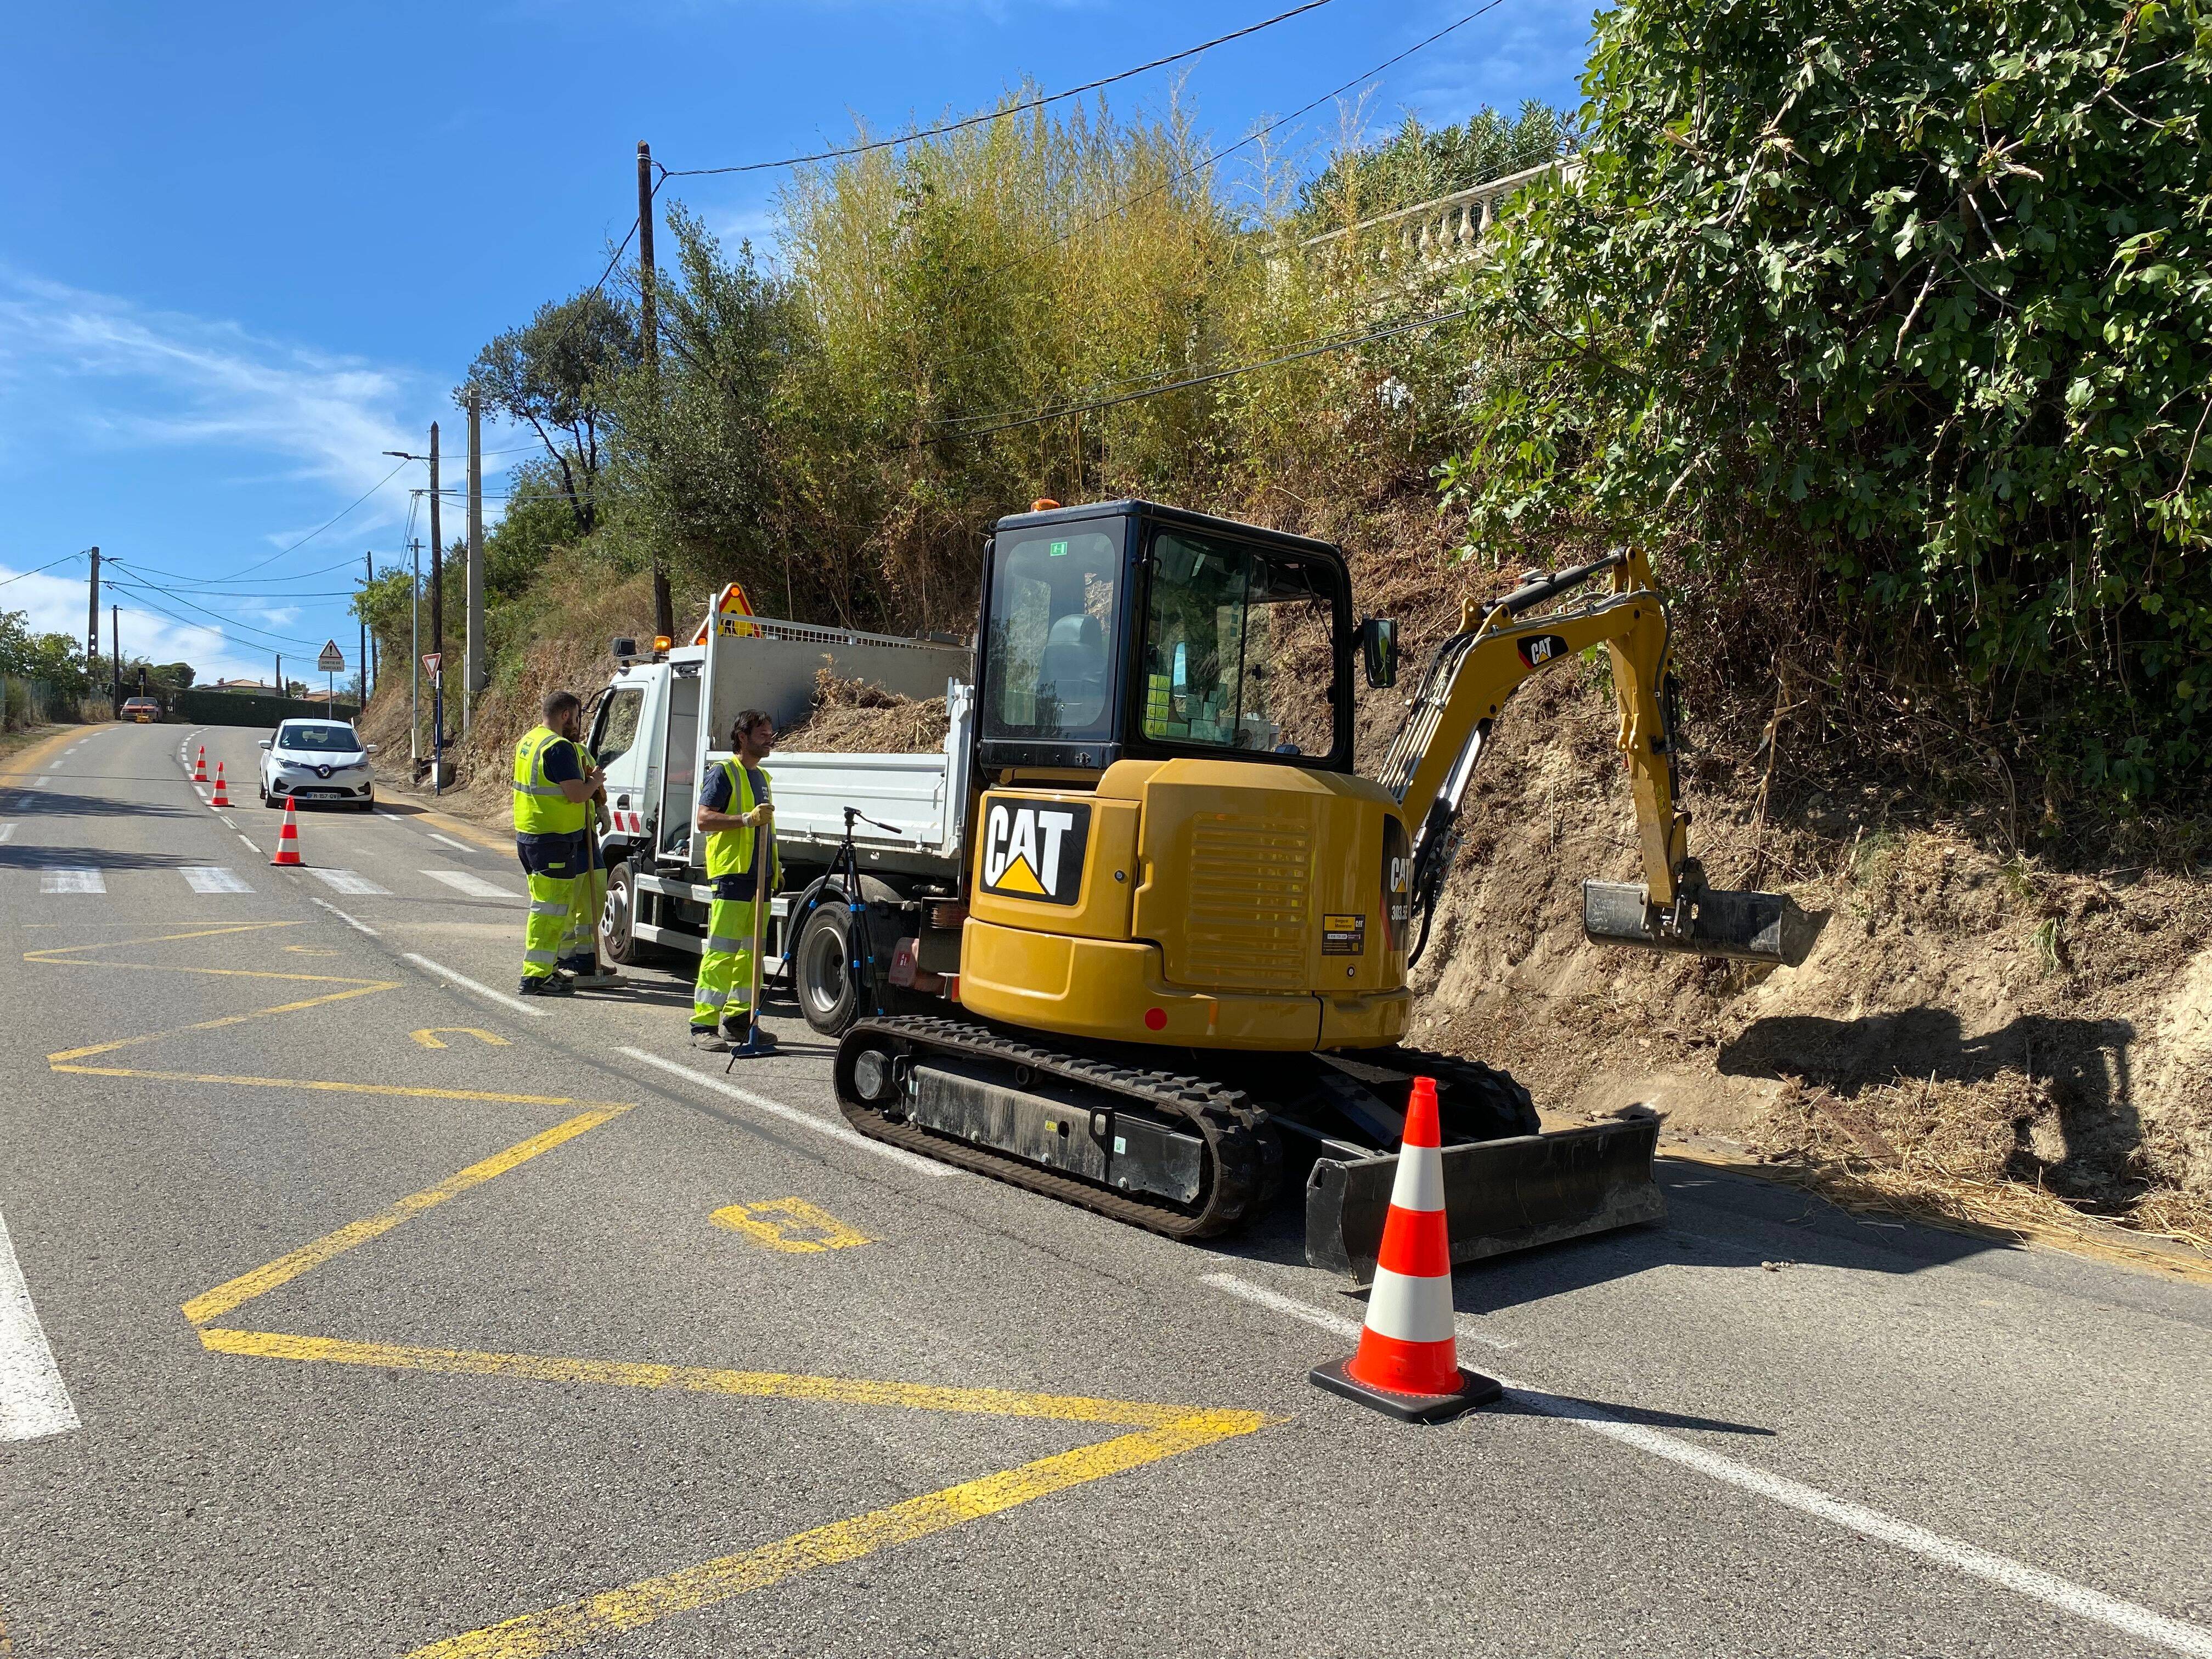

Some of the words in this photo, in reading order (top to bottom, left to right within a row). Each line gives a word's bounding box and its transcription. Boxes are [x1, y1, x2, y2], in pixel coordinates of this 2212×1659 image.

[1531, 637, 1551, 664] CAT
[985, 805, 1073, 895] CAT
[1390, 857, 1410, 893] CAT
